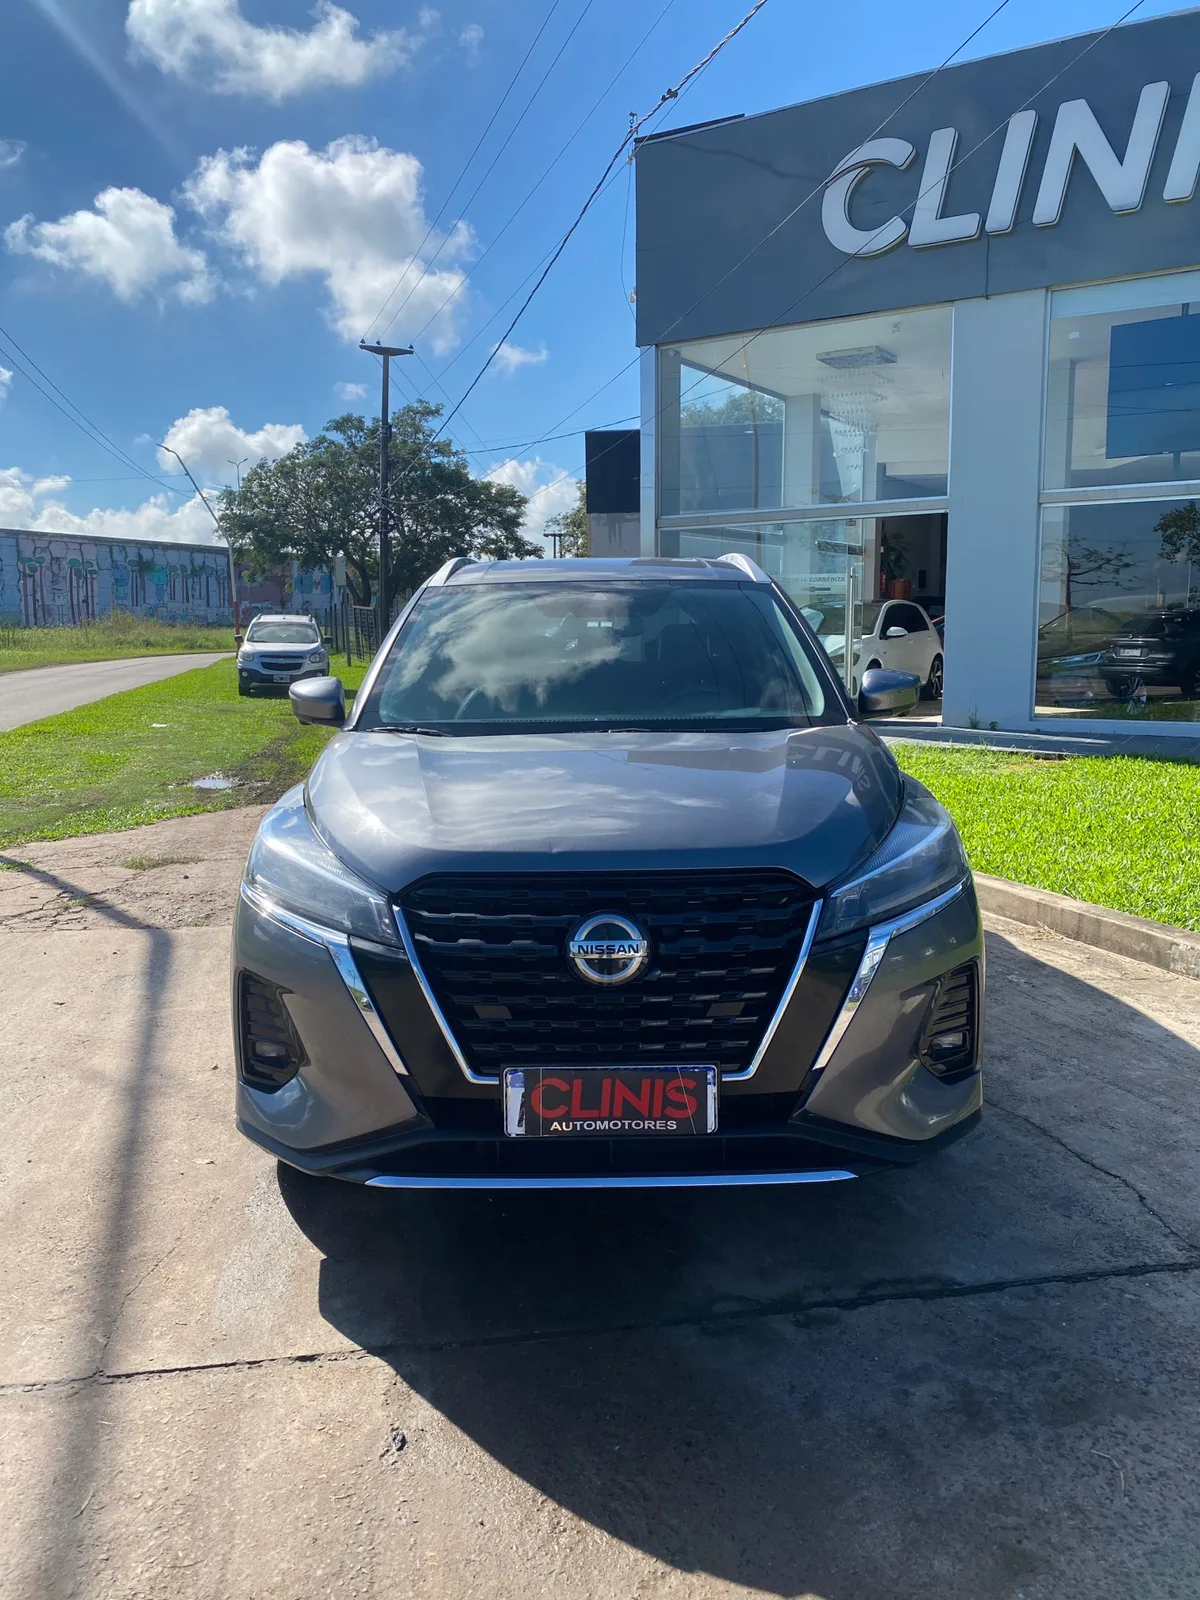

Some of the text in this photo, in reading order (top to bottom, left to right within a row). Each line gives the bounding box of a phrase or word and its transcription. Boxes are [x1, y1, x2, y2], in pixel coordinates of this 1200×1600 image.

[577, 943, 639, 955] NISSAN
[530, 1077, 697, 1119] CLINIS
[549, 1119, 677, 1132] AUTOMOTORES
